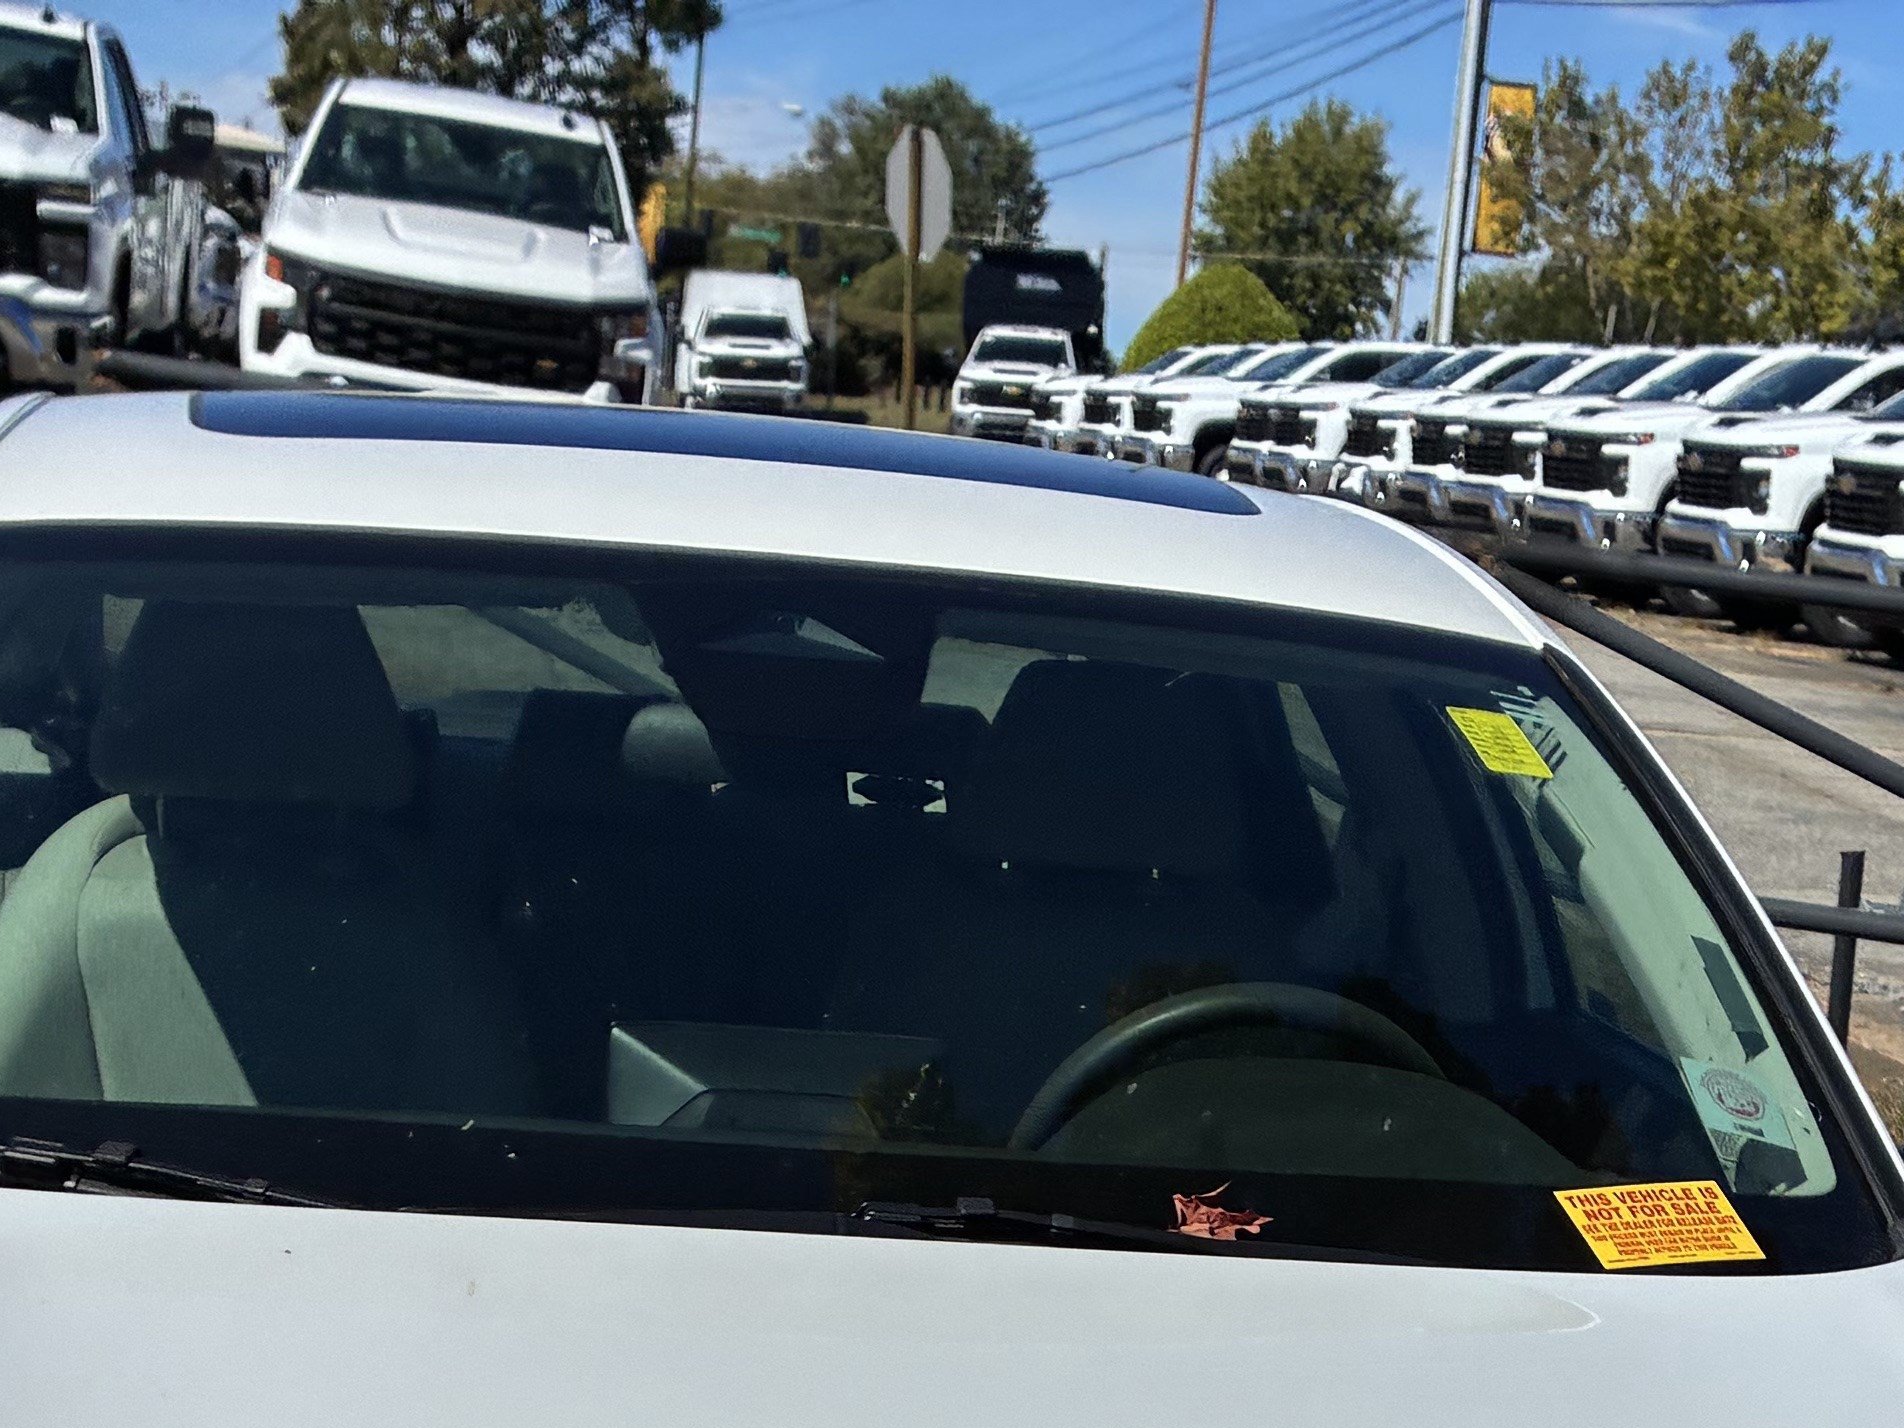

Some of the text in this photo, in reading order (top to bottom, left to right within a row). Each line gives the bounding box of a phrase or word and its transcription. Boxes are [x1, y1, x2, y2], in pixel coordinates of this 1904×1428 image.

[1564, 1187, 1719, 1209] THIS VEHICLE IS
[1582, 1201, 1722, 1222] NOT FOR SALE
